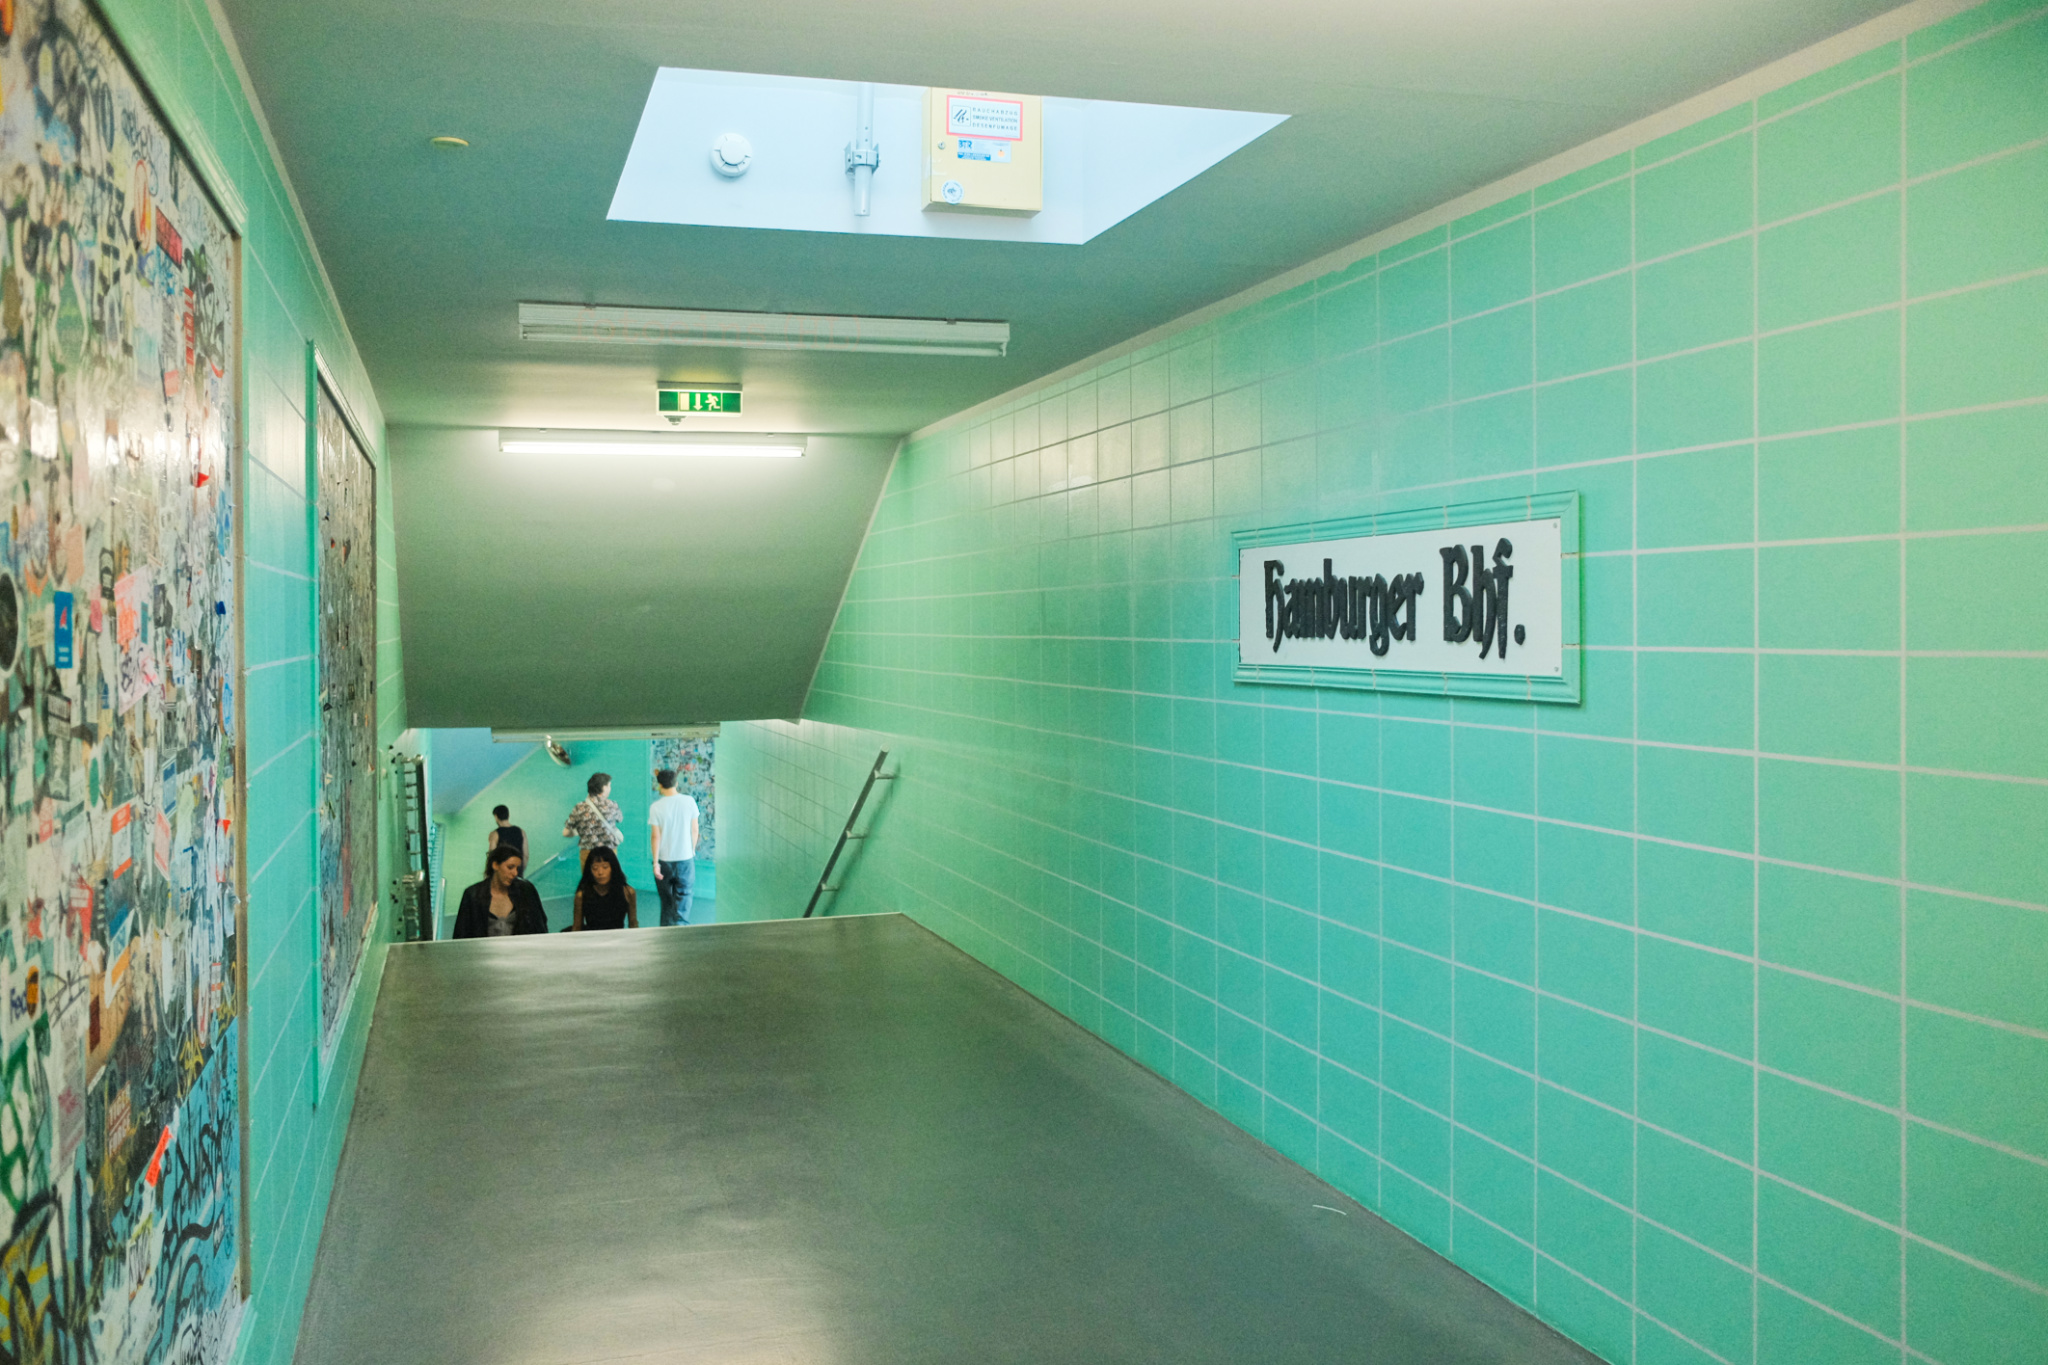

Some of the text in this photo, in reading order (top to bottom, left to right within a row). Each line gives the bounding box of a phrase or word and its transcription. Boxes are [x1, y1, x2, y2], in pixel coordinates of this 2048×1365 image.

[973, 107, 1018, 116] RAUCHABZUG
[1263, 537, 1527, 660] Hamburger Bhf.
